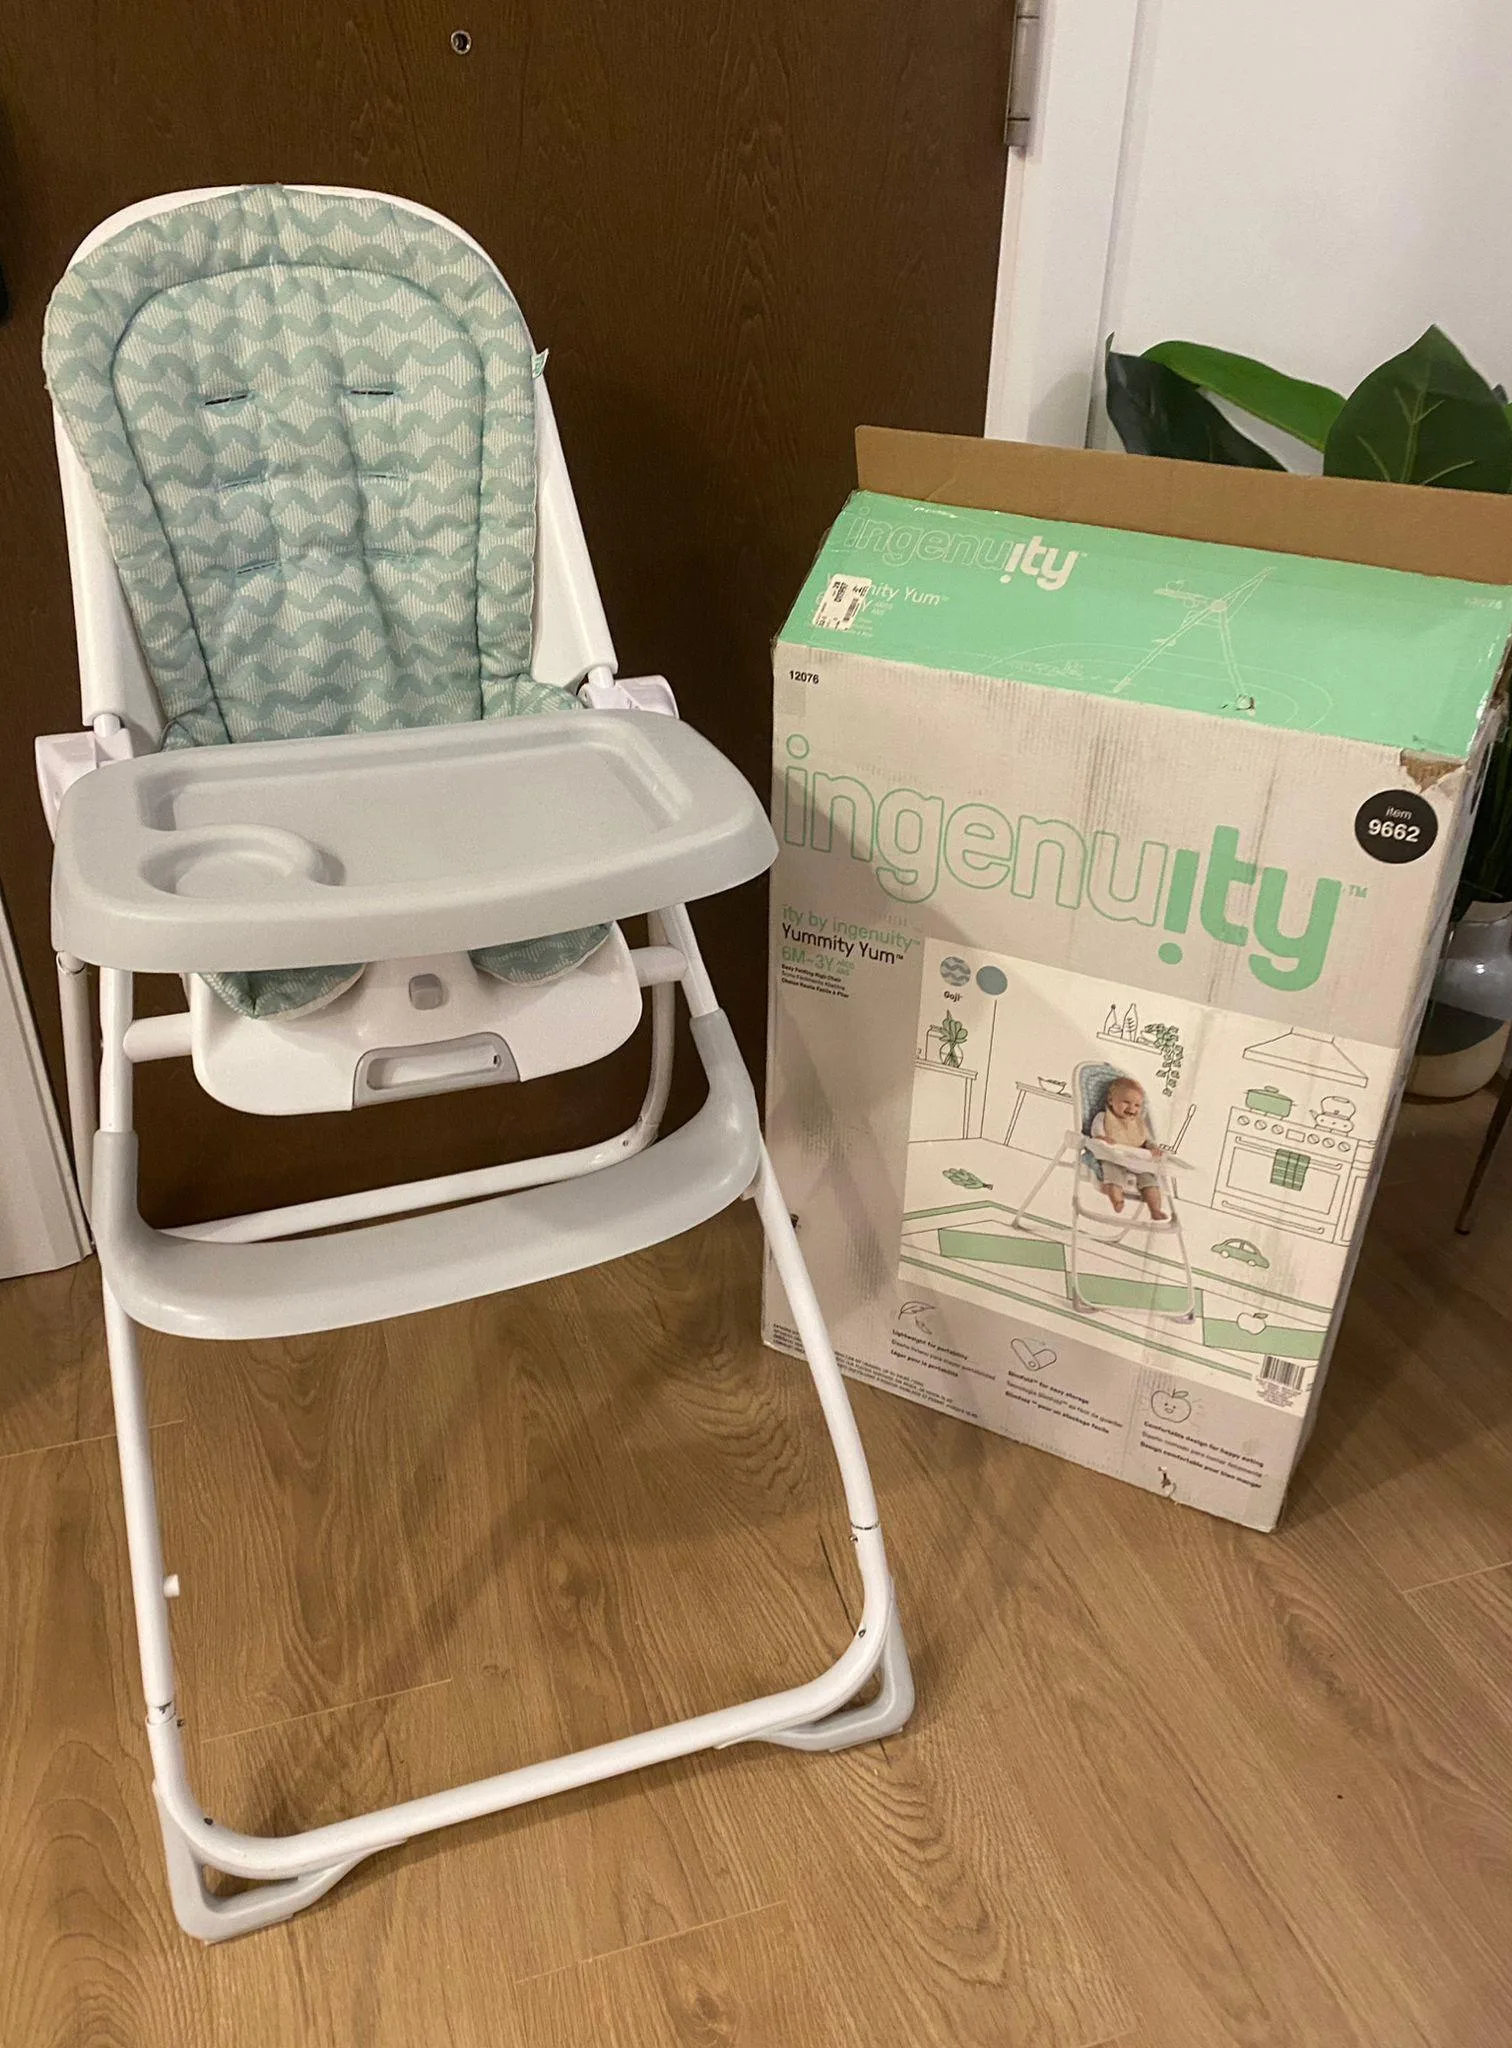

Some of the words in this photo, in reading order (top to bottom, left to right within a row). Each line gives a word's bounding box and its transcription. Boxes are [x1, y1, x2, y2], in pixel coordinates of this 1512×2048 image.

[788, 670, 819, 684] 12076
[1385, 806, 1412, 820] item
[1367, 818, 1421, 843] 9662
[782, 904, 803, 926] ity
[808, 911, 828, 931] by
[782, 922, 855, 957] Yummity
[1143, 1420, 1184, 1439] Comfortable
[1185, 1436, 1208, 1447] design
[1209, 1443, 1219, 1451] for
[1220, 1447, 1241, 1459] happy
[1241, 1455, 1264, 1468] eating
